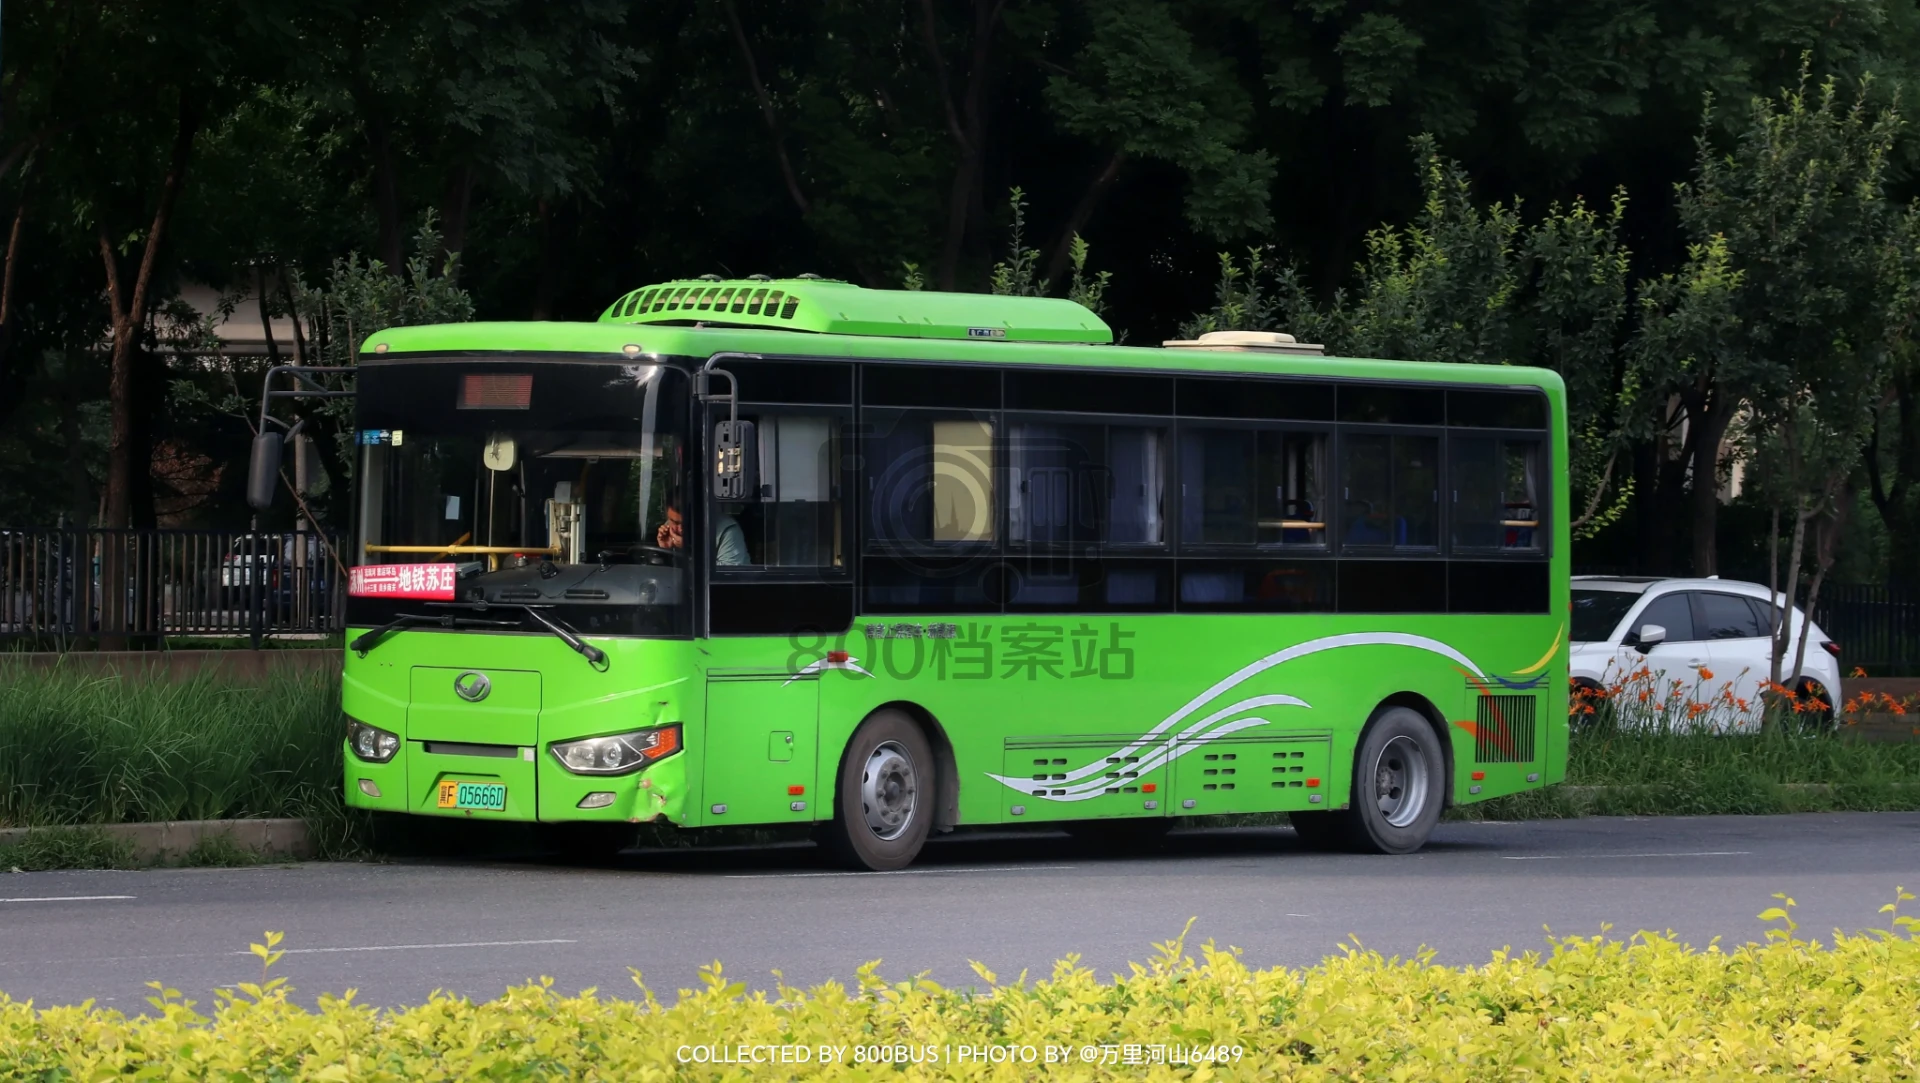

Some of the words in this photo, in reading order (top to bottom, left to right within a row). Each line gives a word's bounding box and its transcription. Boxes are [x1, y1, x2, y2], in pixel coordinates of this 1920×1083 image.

[399, 565, 454, 592] 地铁苏庄
[460, 785, 504, 806] 05666D
